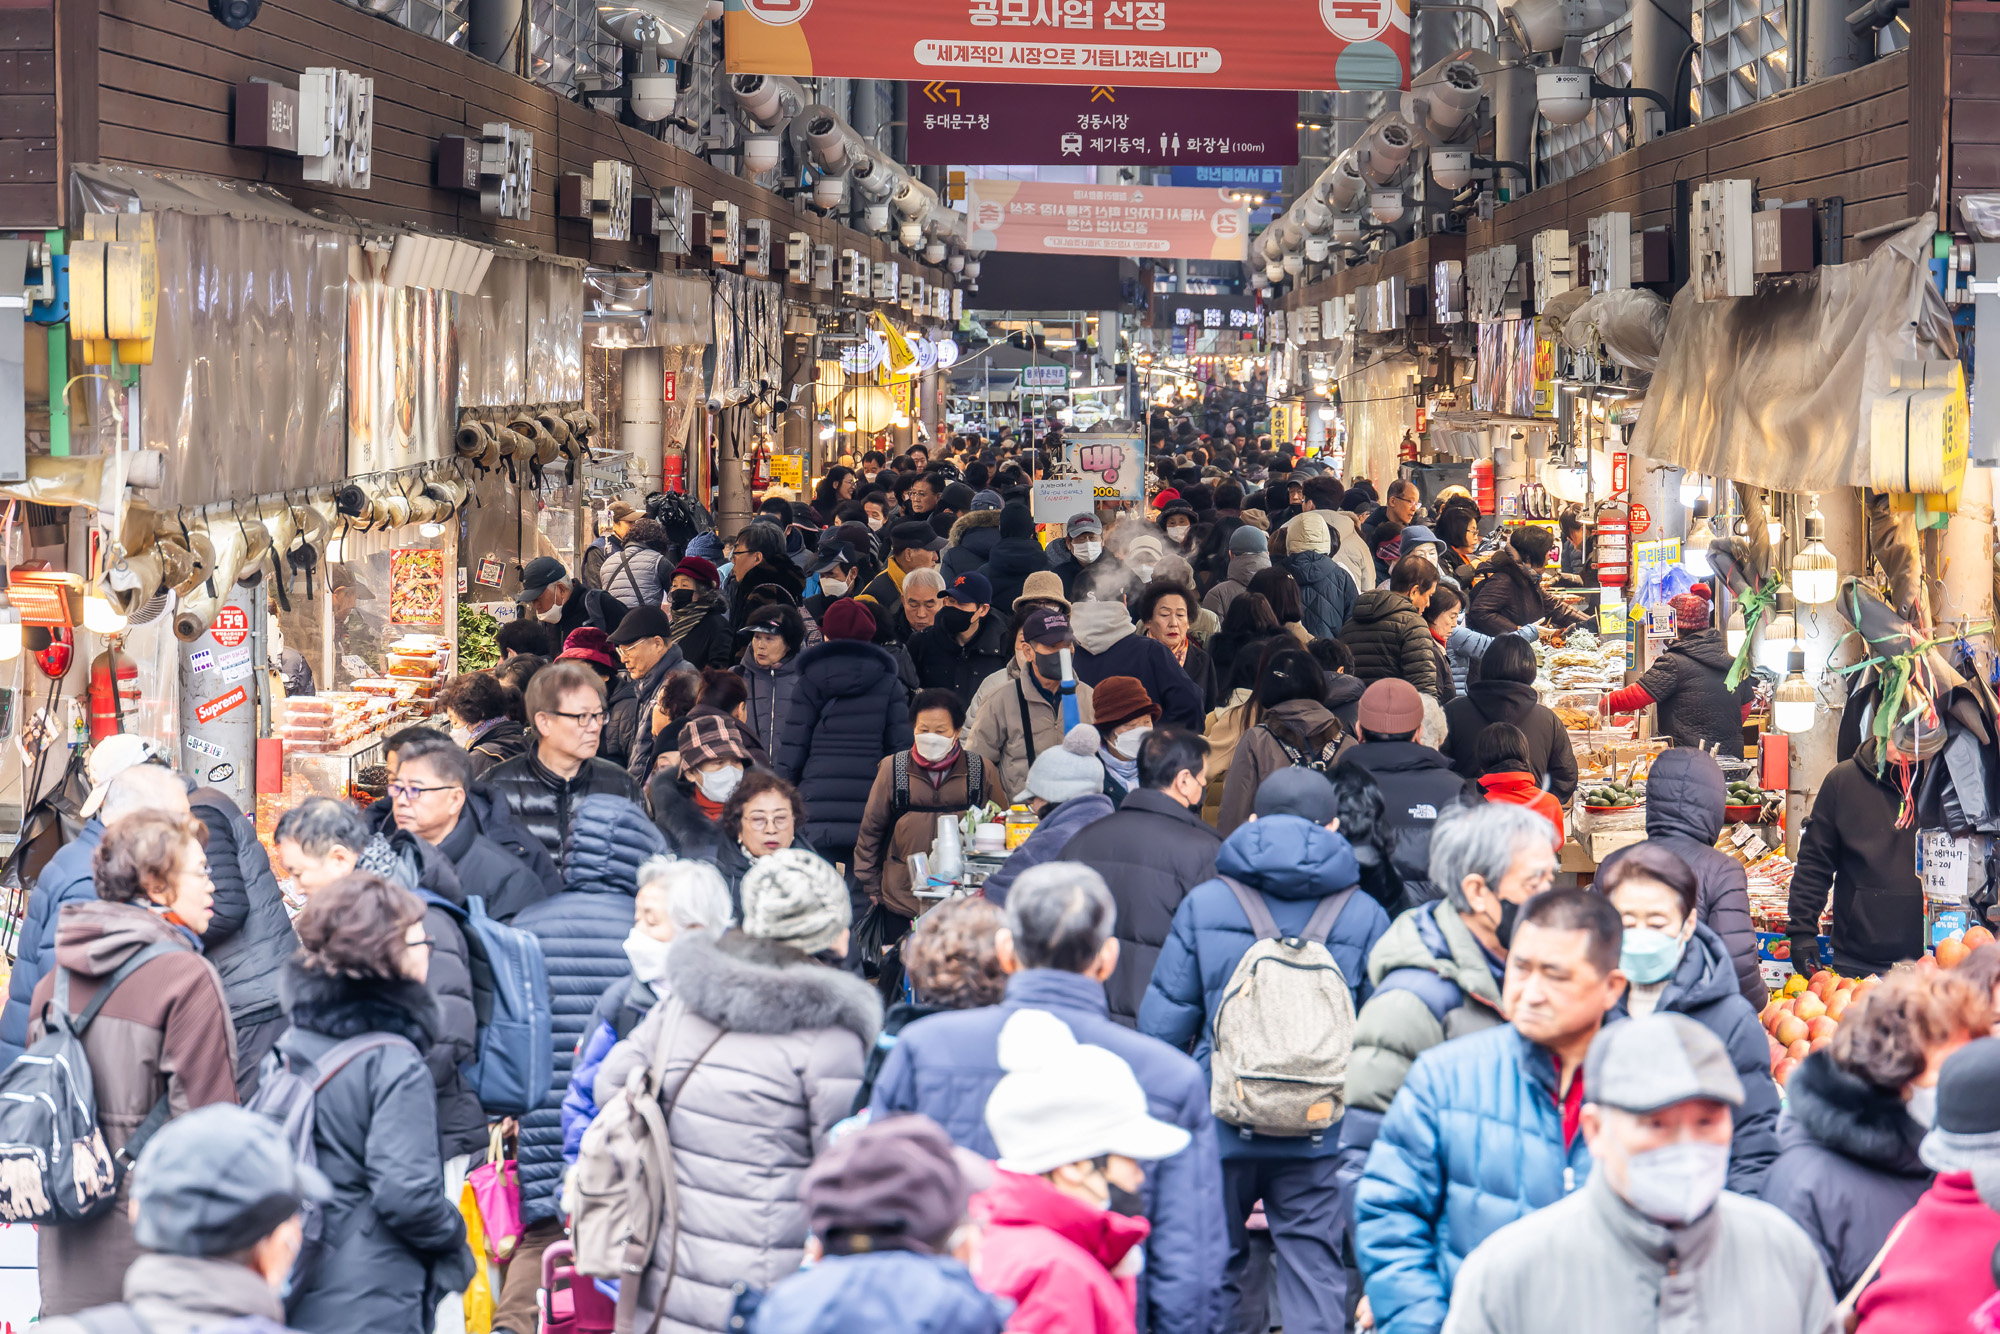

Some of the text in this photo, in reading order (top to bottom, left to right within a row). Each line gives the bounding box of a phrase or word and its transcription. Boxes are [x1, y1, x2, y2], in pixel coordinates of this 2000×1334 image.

[969, 0, 1166, 31] 공모사업 선정
[928, 43, 1209, 70] "세계적인 시장으로 거듭나겠습니다"
[923, 114, 990, 130] 동대문구청
[1077, 114, 1129, 130] 경동시장
[1089, 137, 1265, 154] 제기동역, 화장실 (100m)
[1080, 443, 1125, 485] 빵
[1630, 510, 1647, 521] 1구역
[216, 614, 244, 629] 1구역
[191, 650, 210, 660] SUPER
[194, 662, 214, 673] SEOUL
[198, 690, 244, 719] Supreme
